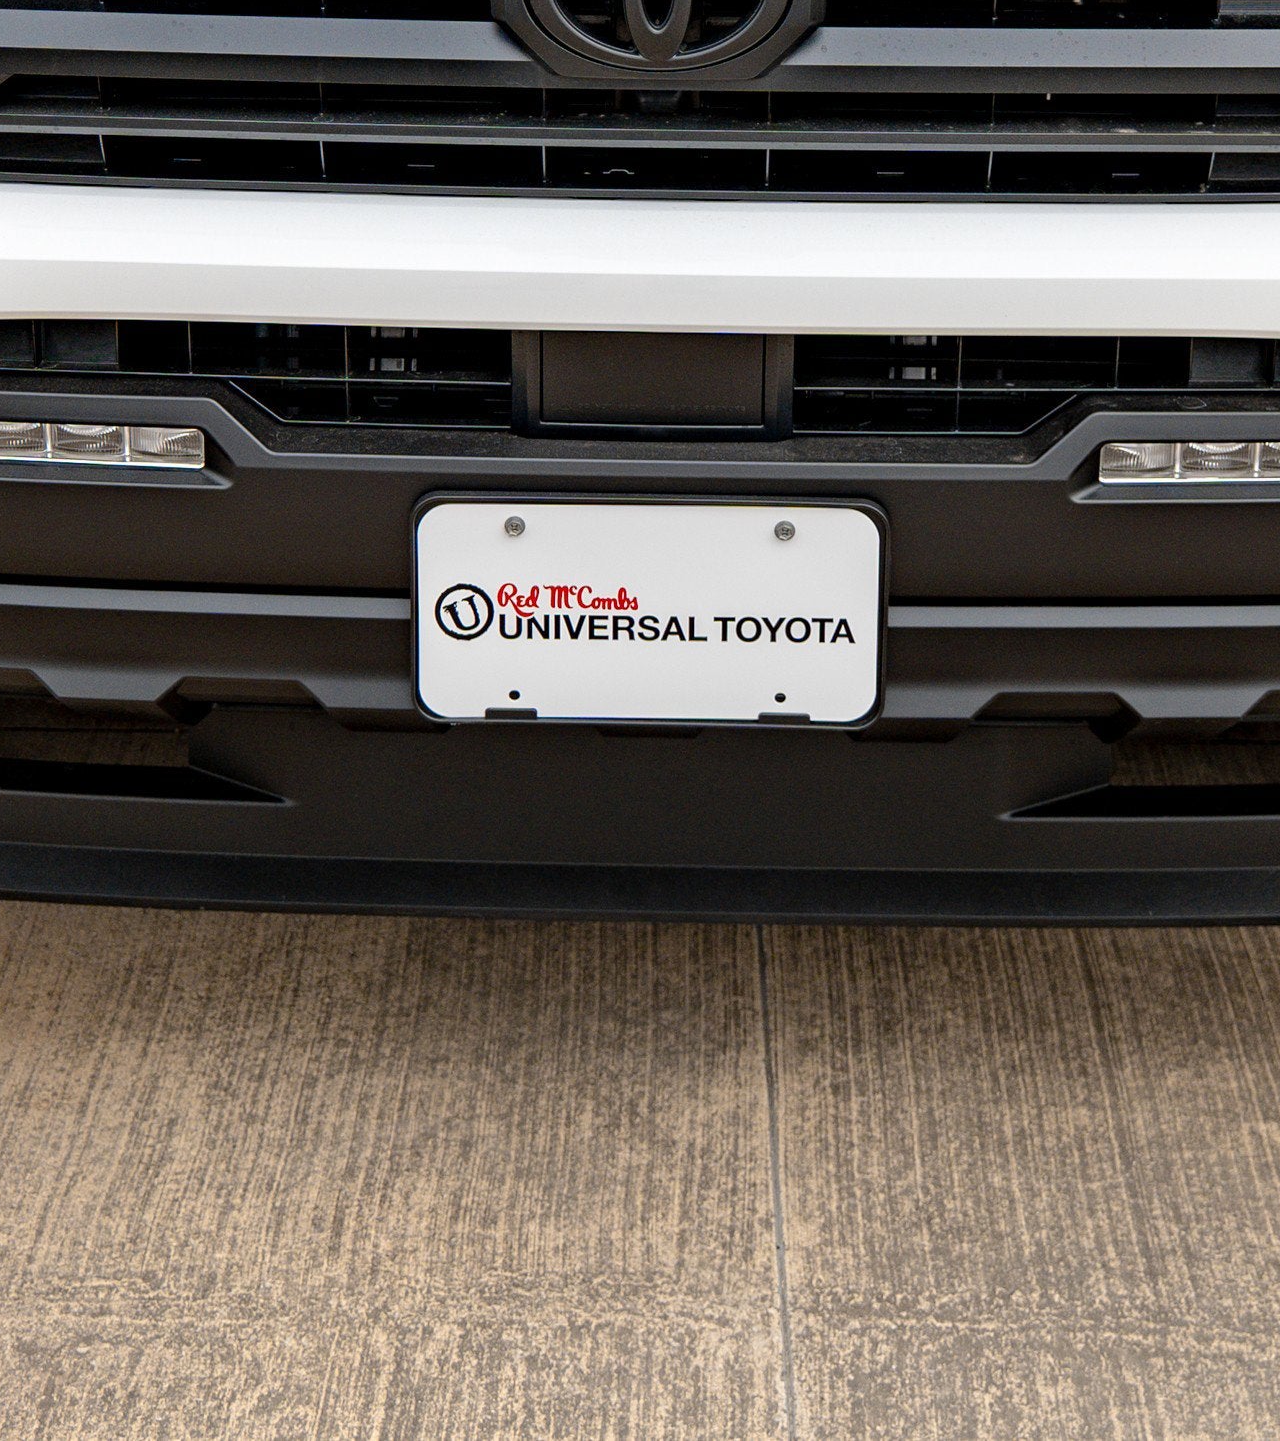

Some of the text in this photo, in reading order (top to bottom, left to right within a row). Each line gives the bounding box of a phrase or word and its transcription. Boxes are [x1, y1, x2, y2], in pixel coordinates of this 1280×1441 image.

[497, 583, 639, 618] Red McCombs
[498, 614, 856, 644] UNIVERSAL TOYOTA
